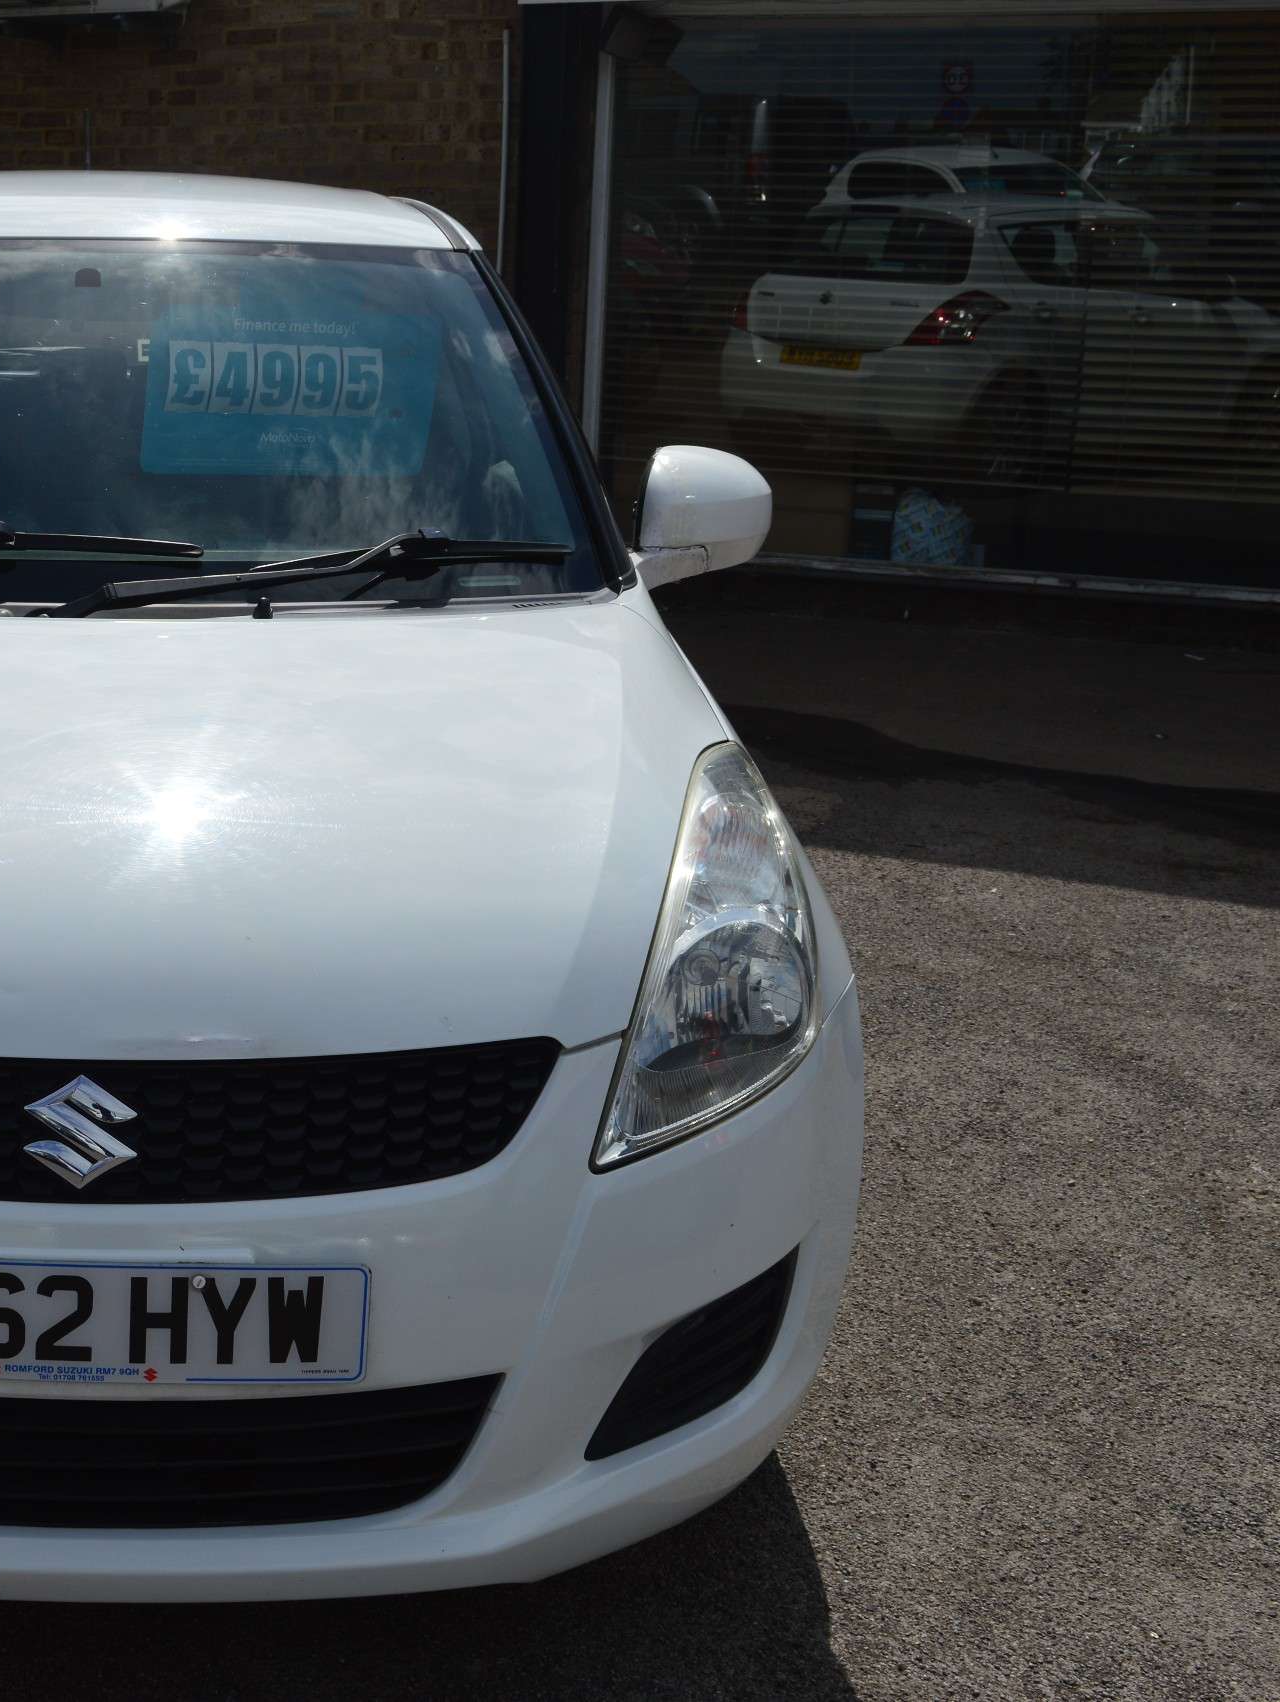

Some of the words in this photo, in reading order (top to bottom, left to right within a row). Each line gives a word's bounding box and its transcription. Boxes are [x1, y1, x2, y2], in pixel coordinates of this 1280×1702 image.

[233, 318, 287, 333] Finance
[288, 321, 312, 334] me
[313, 320, 357, 338] today!
[170, 347, 380, 411] £4995
[128, 1275, 325, 1365] HYW
[4, 1363, 55, 1374] ROMFORD
[56, 1365, 94, 1375] SUZUKI
[95, 1367, 116, 1376] RM7
